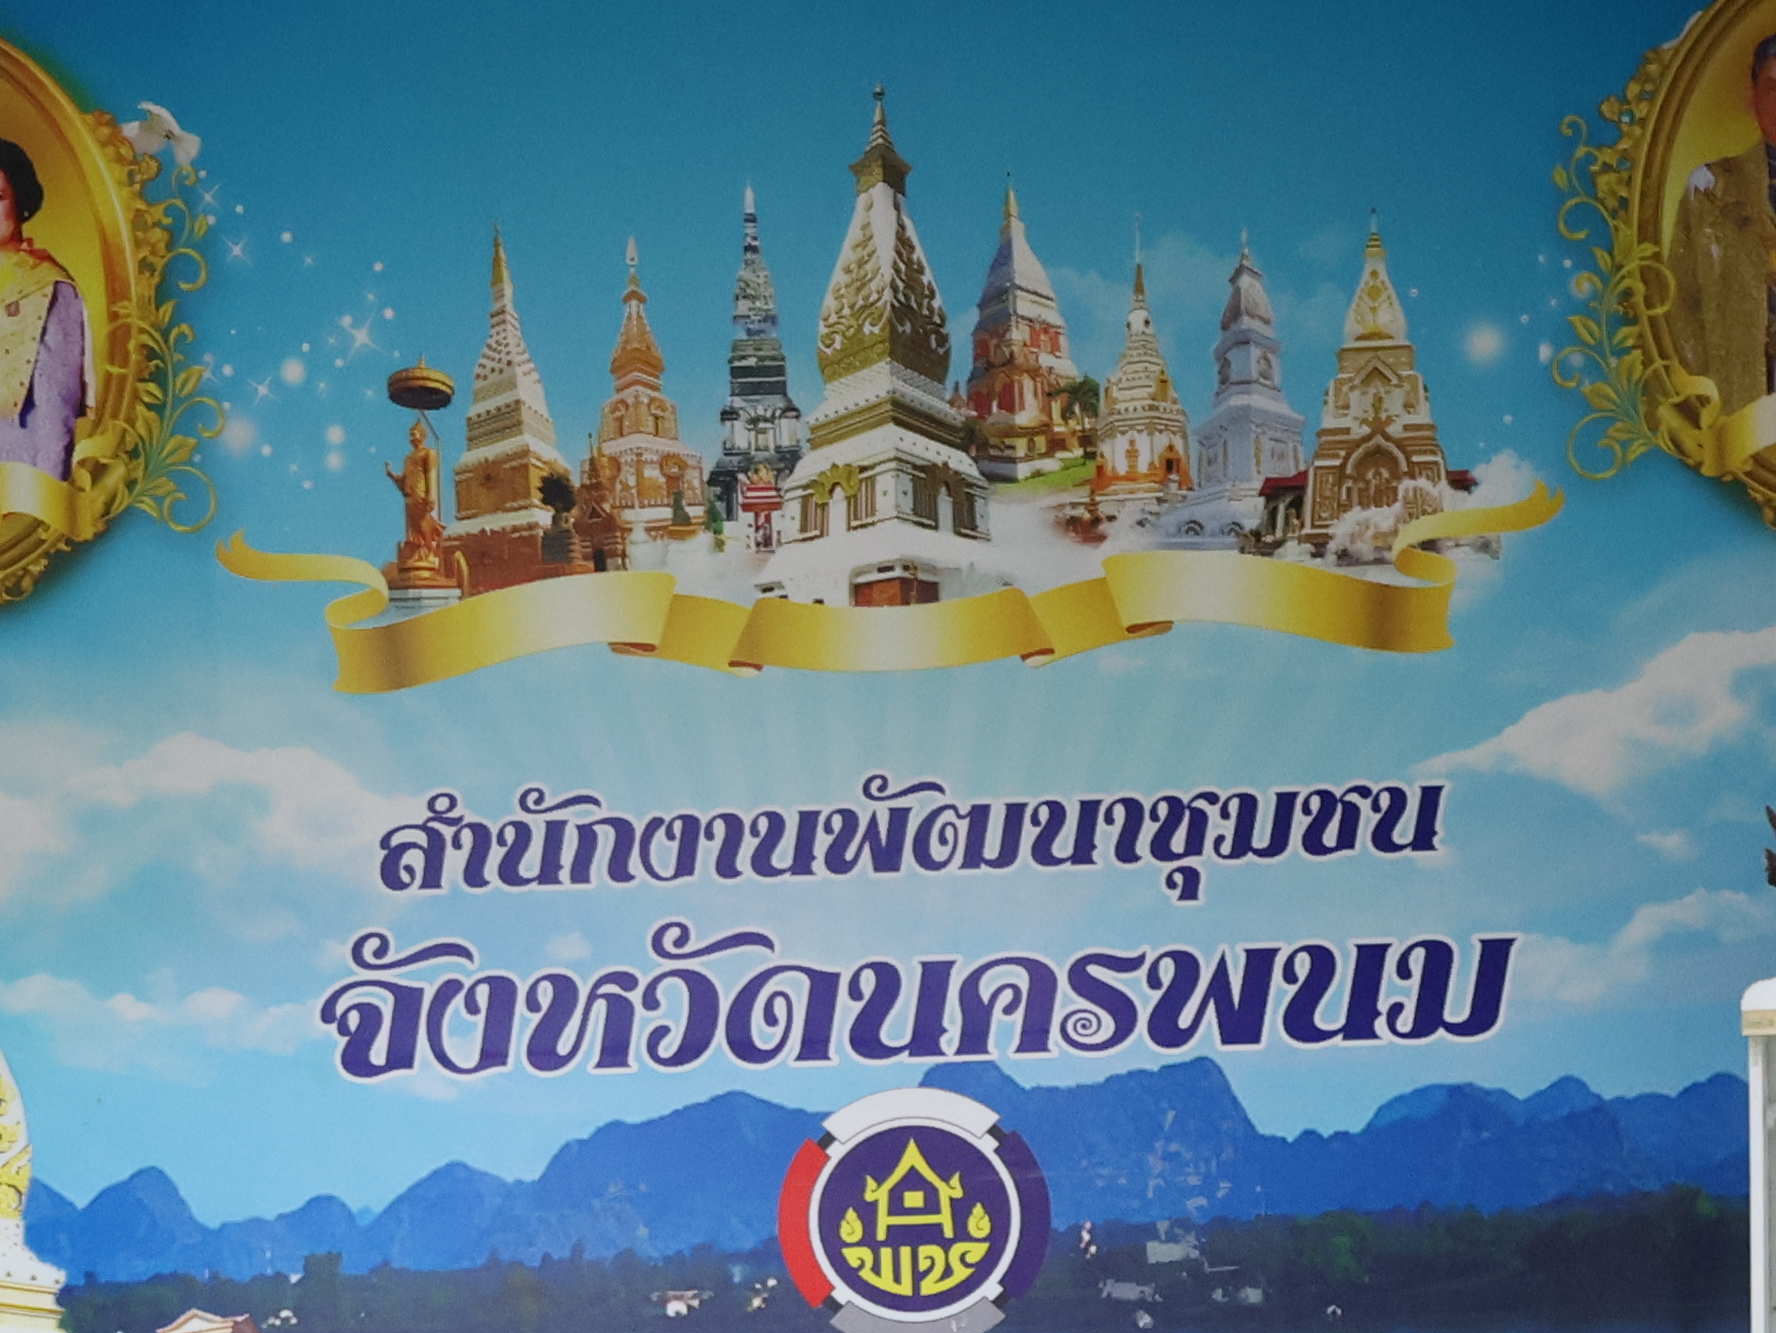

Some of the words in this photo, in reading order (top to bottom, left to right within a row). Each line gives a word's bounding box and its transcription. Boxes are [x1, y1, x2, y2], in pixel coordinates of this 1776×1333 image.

[376, 772, 1446, 903] สำนักงานพัฒนาชุมชน
[320, 920, 1520, 1080] จังหวัดนครพนม
